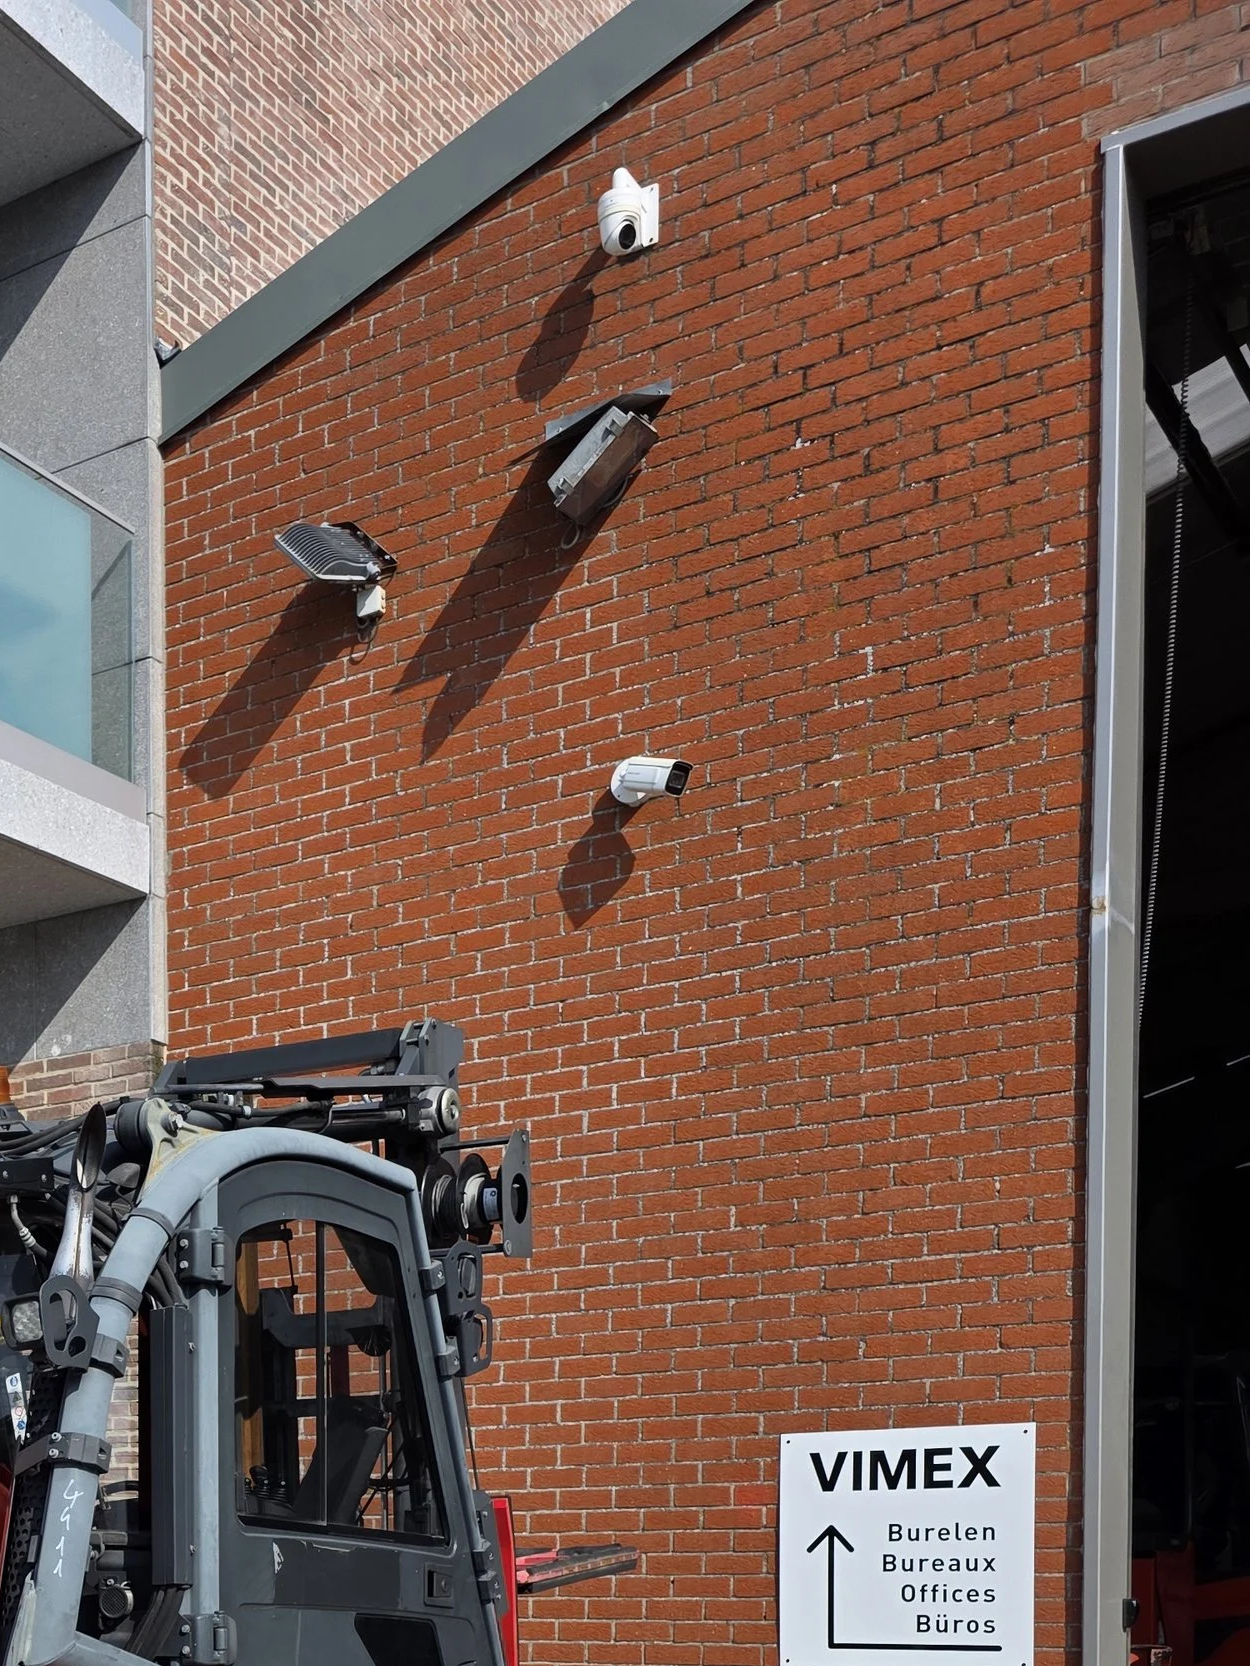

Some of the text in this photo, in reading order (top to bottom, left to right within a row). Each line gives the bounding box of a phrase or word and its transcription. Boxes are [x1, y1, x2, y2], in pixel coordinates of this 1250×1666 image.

[809, 1445, 1001, 1492] VIMEX
[888, 1522, 996, 1542] Burelen
[882, 1553, 996, 1572] Bureaux
[901, 1583, 996, 1603] Offices
[916, 1614, 996, 1634] Büros
